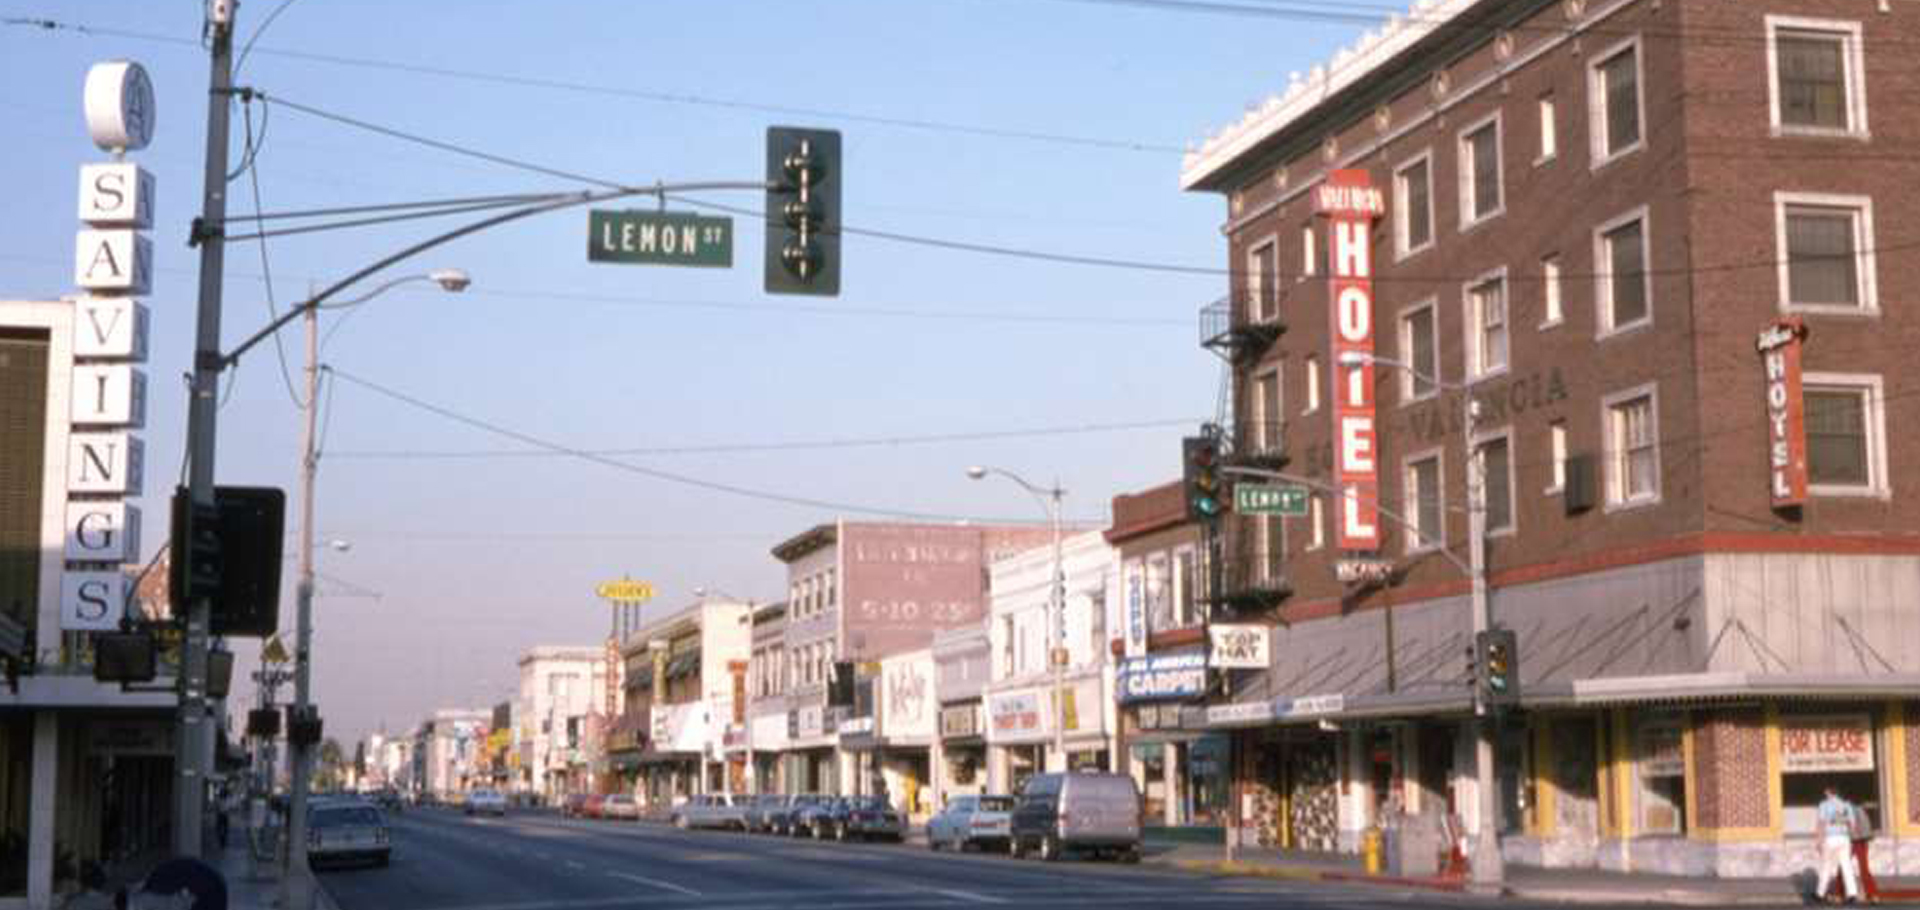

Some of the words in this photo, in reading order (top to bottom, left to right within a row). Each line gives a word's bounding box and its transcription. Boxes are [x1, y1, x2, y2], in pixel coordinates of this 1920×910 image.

[603, 221, 697, 254] LEMON
[702, 226, 722, 245] ST
[1335, 221, 1376, 538] HOTEL
[75, 171, 126, 622] SAVINGS
[1767, 352, 1790, 498] HOTEL
[1217, 646, 1259, 660] HAT
[1220, 631, 1261, 646] TOP
[1780, 727, 1812, 755] FOR
[1815, 727, 1867, 754] LEASE
